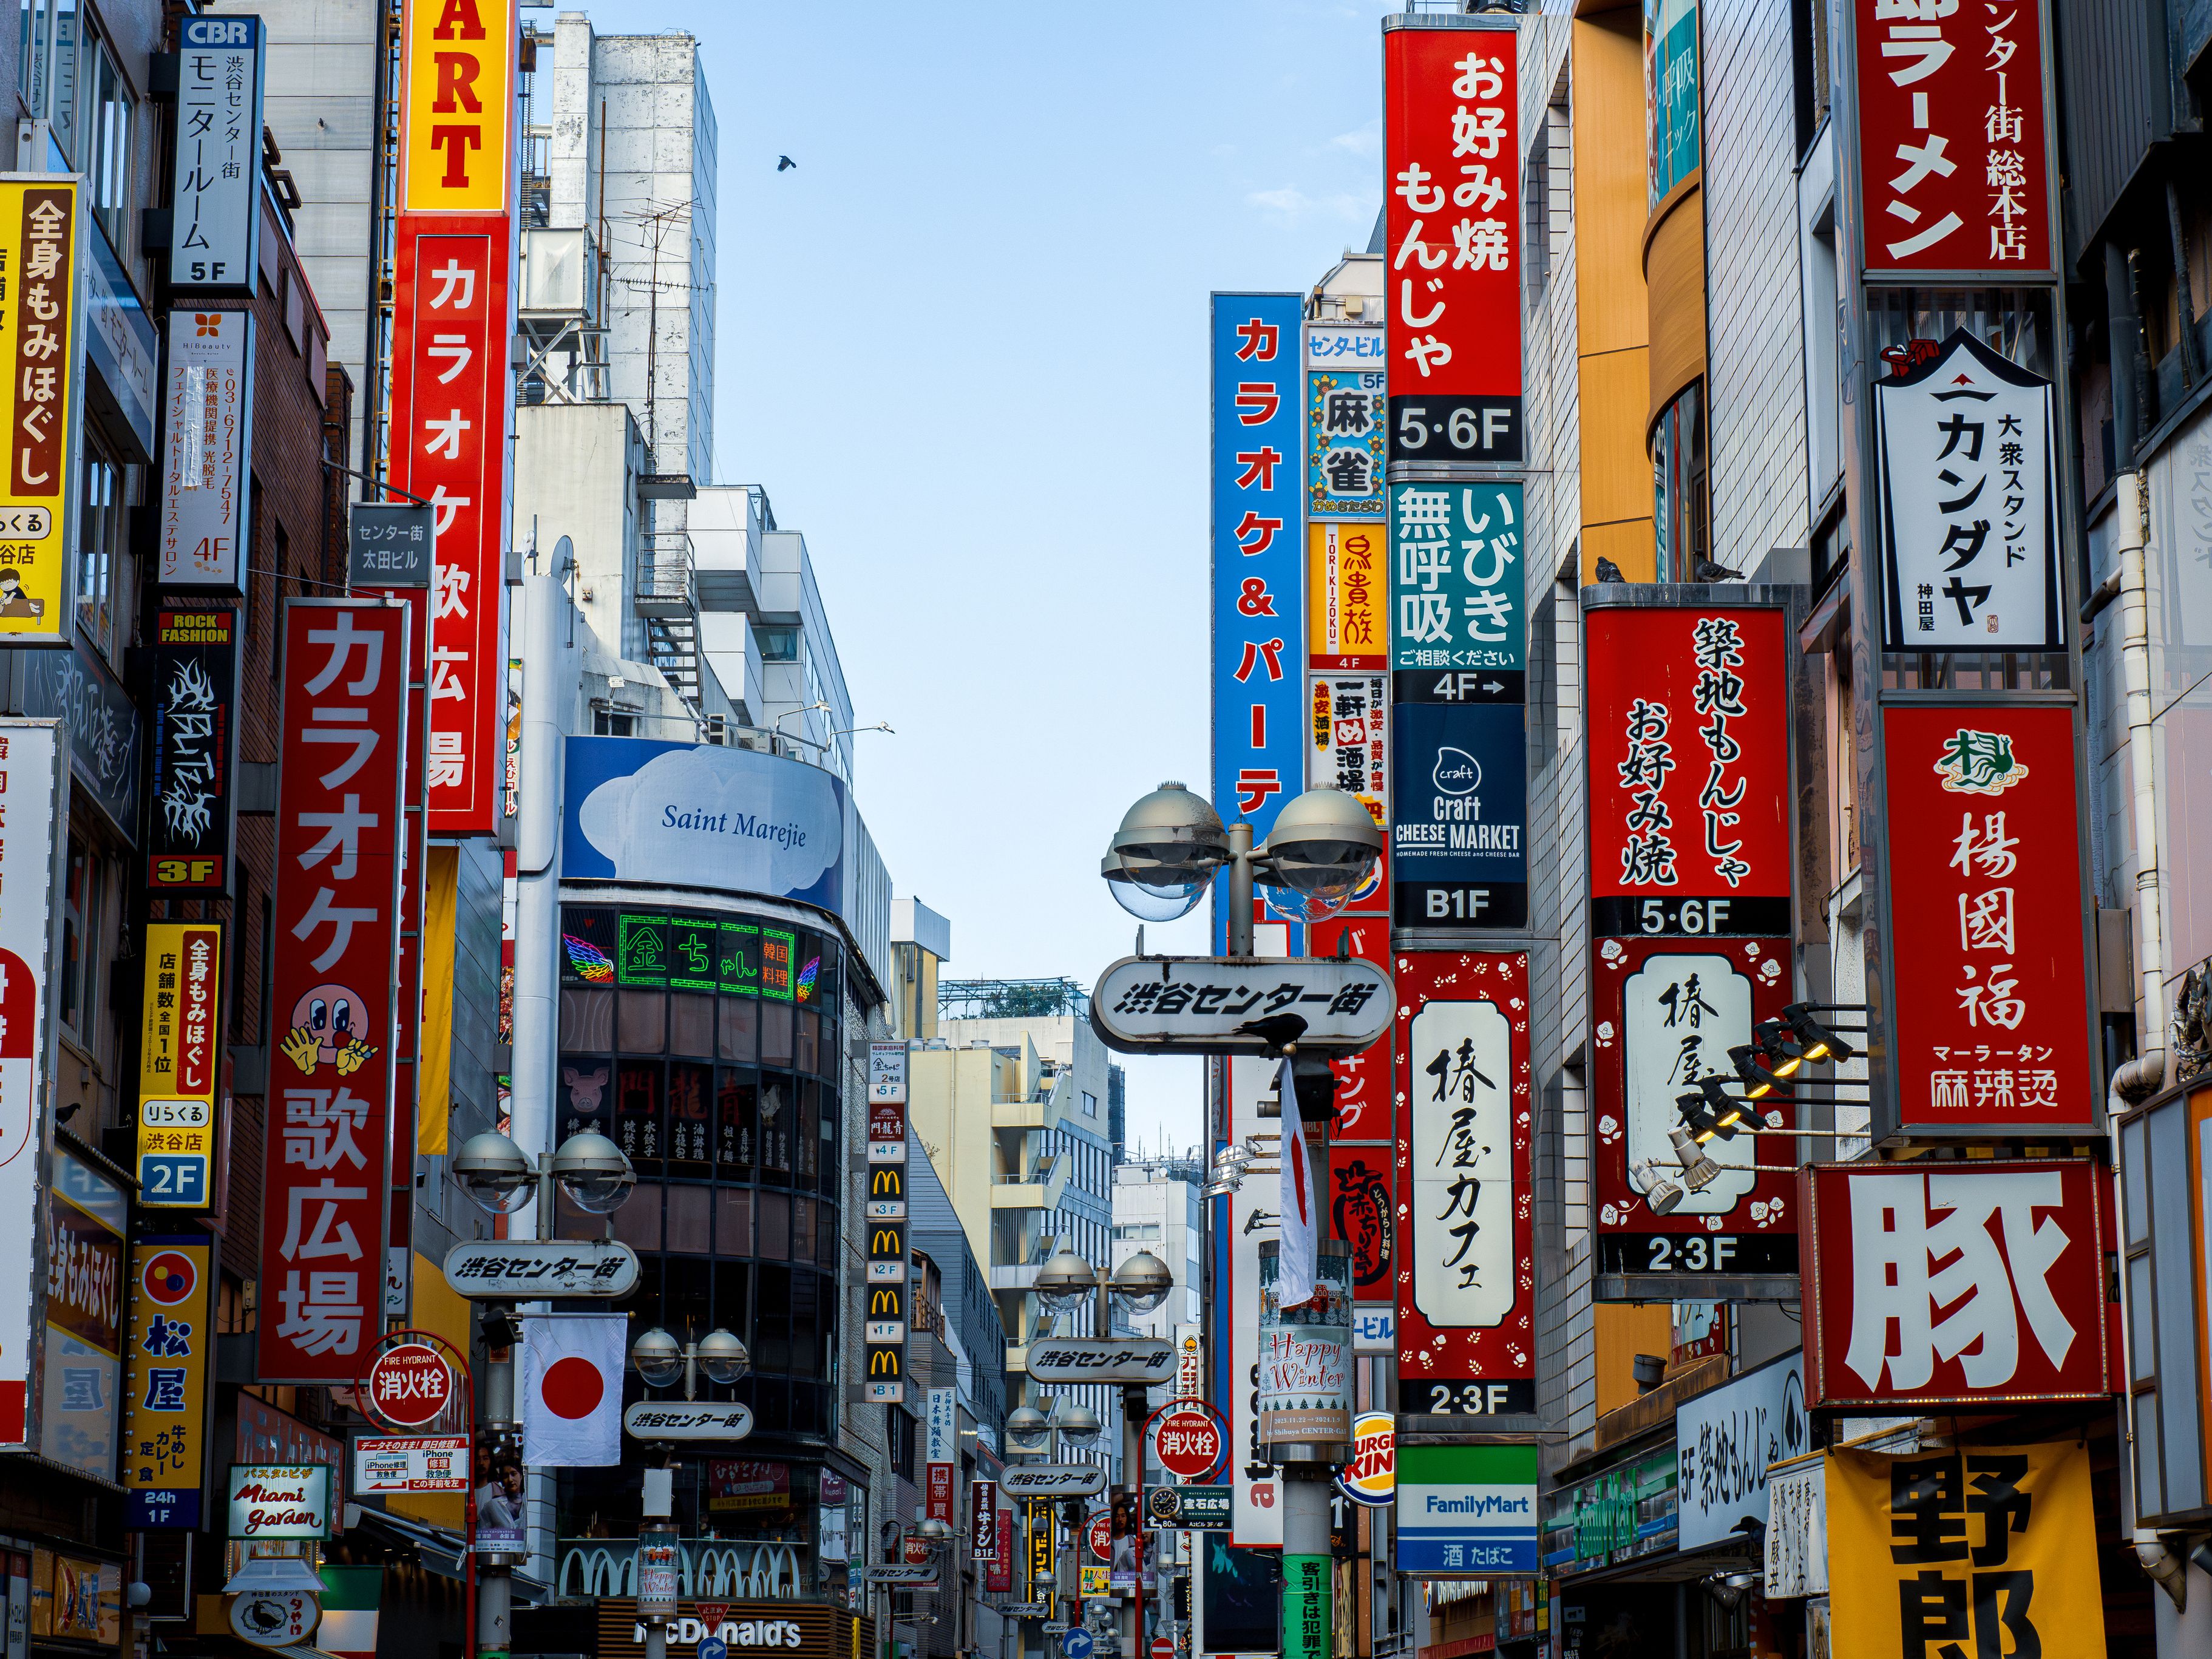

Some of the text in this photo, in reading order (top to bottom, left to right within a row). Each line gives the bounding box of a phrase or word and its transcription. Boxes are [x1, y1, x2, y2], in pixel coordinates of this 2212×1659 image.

[188, 22, 248, 44] CBR
[221, 56, 245, 180] 渋谷センター街
[182, 55, 217, 249] モニタールーム
[1451, 52, 1508, 271] お好み焼
[191, 262, 226, 281] 5F
[21, 200, 66, 485] 全身もみほぐし
[1309, 336, 1384, 357] センタービル
[204, 368, 219, 446] 医療機関提携
[220, 378, 236, 524] 03-6712-7547
[1327, 392, 1369, 493] 麻雀
[165, 367, 185, 576] フェイシャルトータルエステサロン
[202, 450, 217, 490] 光脱毛
[1997, 414, 2026, 568] 大衆スタンド
[1312, 500, 1384, 514] かめきたざわ
[1935, 413, 1993, 626] カンダヤ
[359, 524, 423, 541] センター街
[192, 537, 229, 562] 4F
[362, 550, 418, 569] 太田ビル
[1398, 487, 1453, 644] 無呼吸
[1461, 488, 1518, 642] いびき
[1328, 534, 1337, 639] TORIKIZOKU
[1343, 535, 1372, 645] 鳥貴族
[174, 614, 217, 628] ROCK
[1917, 582, 1935, 632] 神田屋
[161, 629, 228, 642] FASHION
[1339, 657, 1360, 668] 4F
[1399, 650, 1515, 667] ご相談ください
[1433, 673, 1477, 701] 4F
[1314, 684, 1330, 746] 激安酒場
[1334, 680, 1368, 793] 一軒め酒場
[1369, 677, 1384, 792] 毎日が激安・品質が自慢
[1693, 617, 1751, 887] 築地もんじゃ
[1440, 764, 1473, 779] craft
[1618, 699, 1678, 886] お好み焼
[1433, 796, 1481, 821] Craft
[662, 805, 807, 850] Saint Marejie
[1396, 824, 1520, 850] CHEESE MARKET
[157, 860, 214, 883] 3F
[1427, 889, 1490, 918] B1F
[1949, 810, 2026, 1030] 楊國福
[626, 927, 757, 979] 金ちゃん
[763, 941, 789, 963] 韓国
[276, 612, 384, 1357] カラオケ歌広場
[762, 966, 788, 987] 料理
[154, 952, 177, 1073] 店舗数全国1位
[186, 938, 210, 1088] 全身もみほぐし
[1113, 982, 1379, 1016] 渋谷センター街
[873, 1057, 900, 1071] 金ちゃん
[1933, 1045, 2054, 1063] マーラータン
[881, 1074, 901, 1082] 2号店
[1930, 1068, 2058, 1108] 麻辣烫
[149, 1107, 203, 1122] りらくる
[146, 1133, 203, 1152] 渋谷店
[643, 1120, 656, 1158] 水餃子
[1425, 1037, 1497, 1291] 椿屋カフェ
[152, 1164, 197, 1193] 2F
[1373, 1188, 1391, 1260] とうがらし料理
[454, 1256, 626, 1279] 渋谷センター街
[1844, 1171, 2077, 1393] 豚
[141, 1314, 192, 1412] 松屋
[384, 1355, 436, 1366] FIRE HYDRANT
[1036, 1351, 1171, 1368] 渋谷センター街
[1269, 1331, 1343, 1367] Happy
[379, 1368, 444, 1401] 消火栓
[876, 1385, 896, 1396] B1
[1269, 1363, 1345, 1391] Winter
[631, 1413, 746, 1428] 渋谷センター街
[931, 1394, 941, 1459] 日本舞踊教室
[1274, 1428, 1300, 1437] Shibuya
[155, 1431, 170, 1475] カレー
[172, 1425, 186, 1470] 牛めし
[361, 1439, 460, 1451] データそのまま! 即日修理!
[422, 1450, 453, 1458] iPhone
[1162, 1431, 1214, 1456] 消火栓
[138, 1441, 155, 1482] 定食
[244, 1468, 314, 1479] パスタとピザ
[425, 1469, 452, 1479] 救急便
[429, 1458, 449, 1469] 修理
[1681, 1406, 1779, 1518] 5F 築地もんじゃ
[413, 1479, 460, 1488] この手前を左
[1006, 1470, 1099, 1486] 渋谷センター街
[144, 1491, 176, 1504] 24h
[233, 1484, 306, 1504] Miami
[980, 1482, 989, 1511] 仙台炭焼
[1184, 1498, 1230, 1510] 宝石広場
[1427, 1495, 1529, 1518] FamilyMart
[149, 1510, 170, 1522] 1F
[977, 1511, 991, 1547] 牛タン
[974, 1549, 994, 1558] B1F
[1443, 1544, 1514, 1567] 酒 たばこ
[1888, 1454, 2042, 1659] 野郎
[643, 1568, 675, 1584] Happy
[643, 1581, 674, 1594] Winter
[869, 1569, 931, 1578] 渋谷センター街
[999, 1604, 1045, 1613] 渋谷センター街
[1301, 1561, 1321, 1659] 客引きは犯罪で
